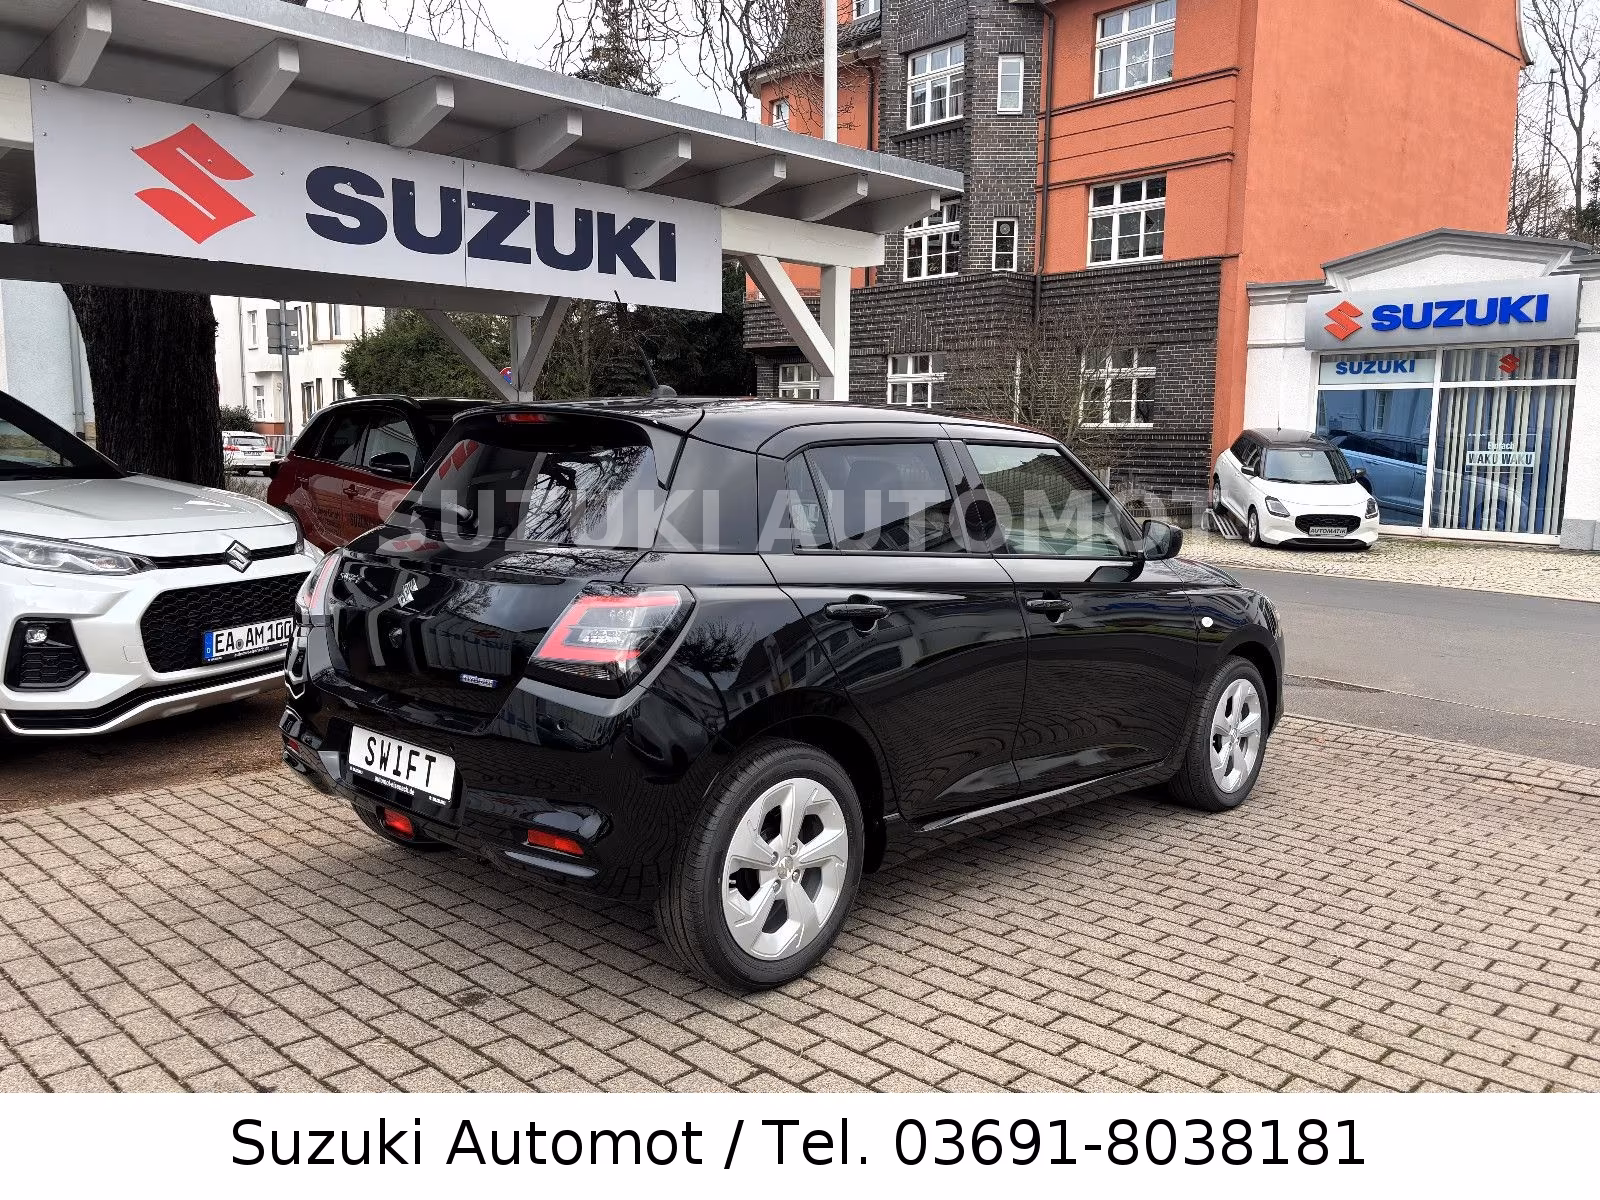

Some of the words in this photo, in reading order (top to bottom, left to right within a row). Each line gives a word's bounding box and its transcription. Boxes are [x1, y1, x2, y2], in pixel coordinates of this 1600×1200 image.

[305, 165, 677, 283] SUZUKI
[1371, 294, 1549, 332] SUZUKI
[1335, 359, 1416, 376] SUZUKI
[1468, 453, 1498, 465] WAKU
[1501, 453, 1533, 466] WAKU
[215, 631, 235, 654] EA
[245, 625, 265, 648] AM
[364, 736, 437, 788] SWIFT
